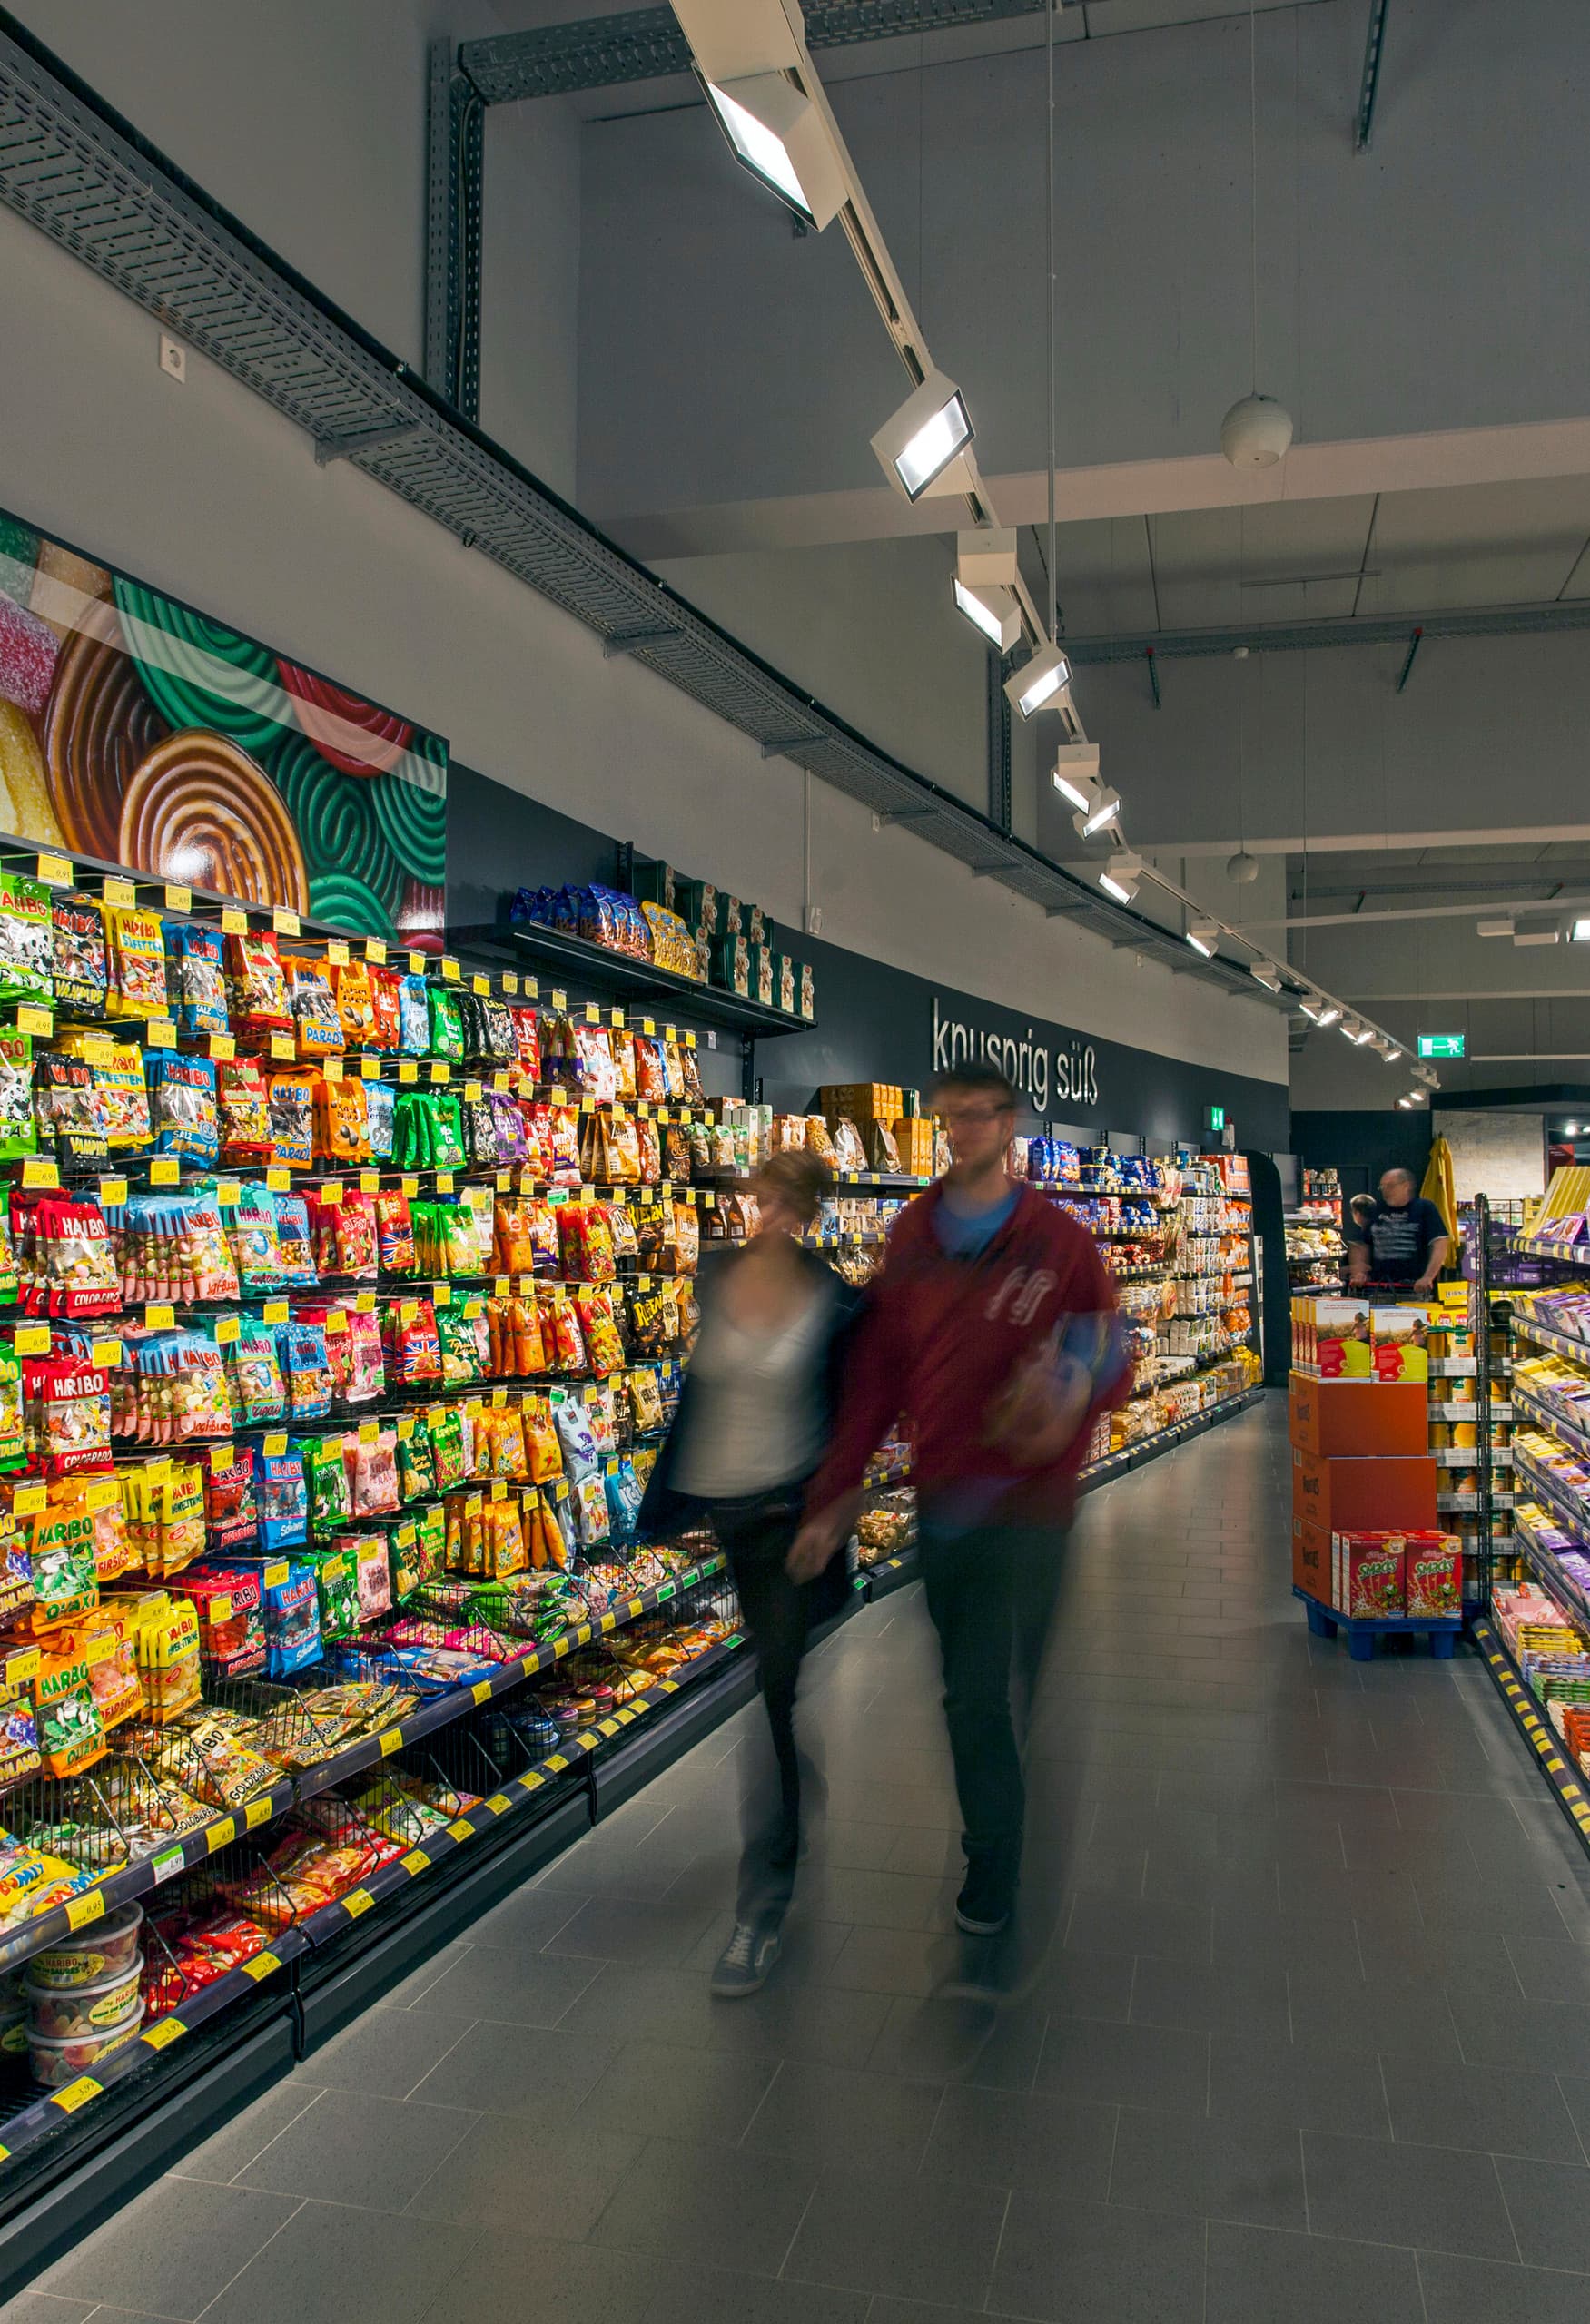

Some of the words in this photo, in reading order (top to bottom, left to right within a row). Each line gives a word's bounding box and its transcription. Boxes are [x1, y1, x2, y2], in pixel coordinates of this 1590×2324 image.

[166, 1061, 210, 1088] HARIBO
[1057, 1040, 1098, 1106] süß
[41, 1173, 56, 1181] 0,95
[62, 1217, 105, 1237] HAIBO
[33, 1338, 48, 1347] 0,95
[54, 1373, 104, 1398] HARIBO
[38, 1516, 94, 1547] HARIBO
[1358, 1558, 1398, 1579] Smacks
[1415, 1558, 1455, 1579] Smacks
[86, 1900, 102, 1915] 0,95
